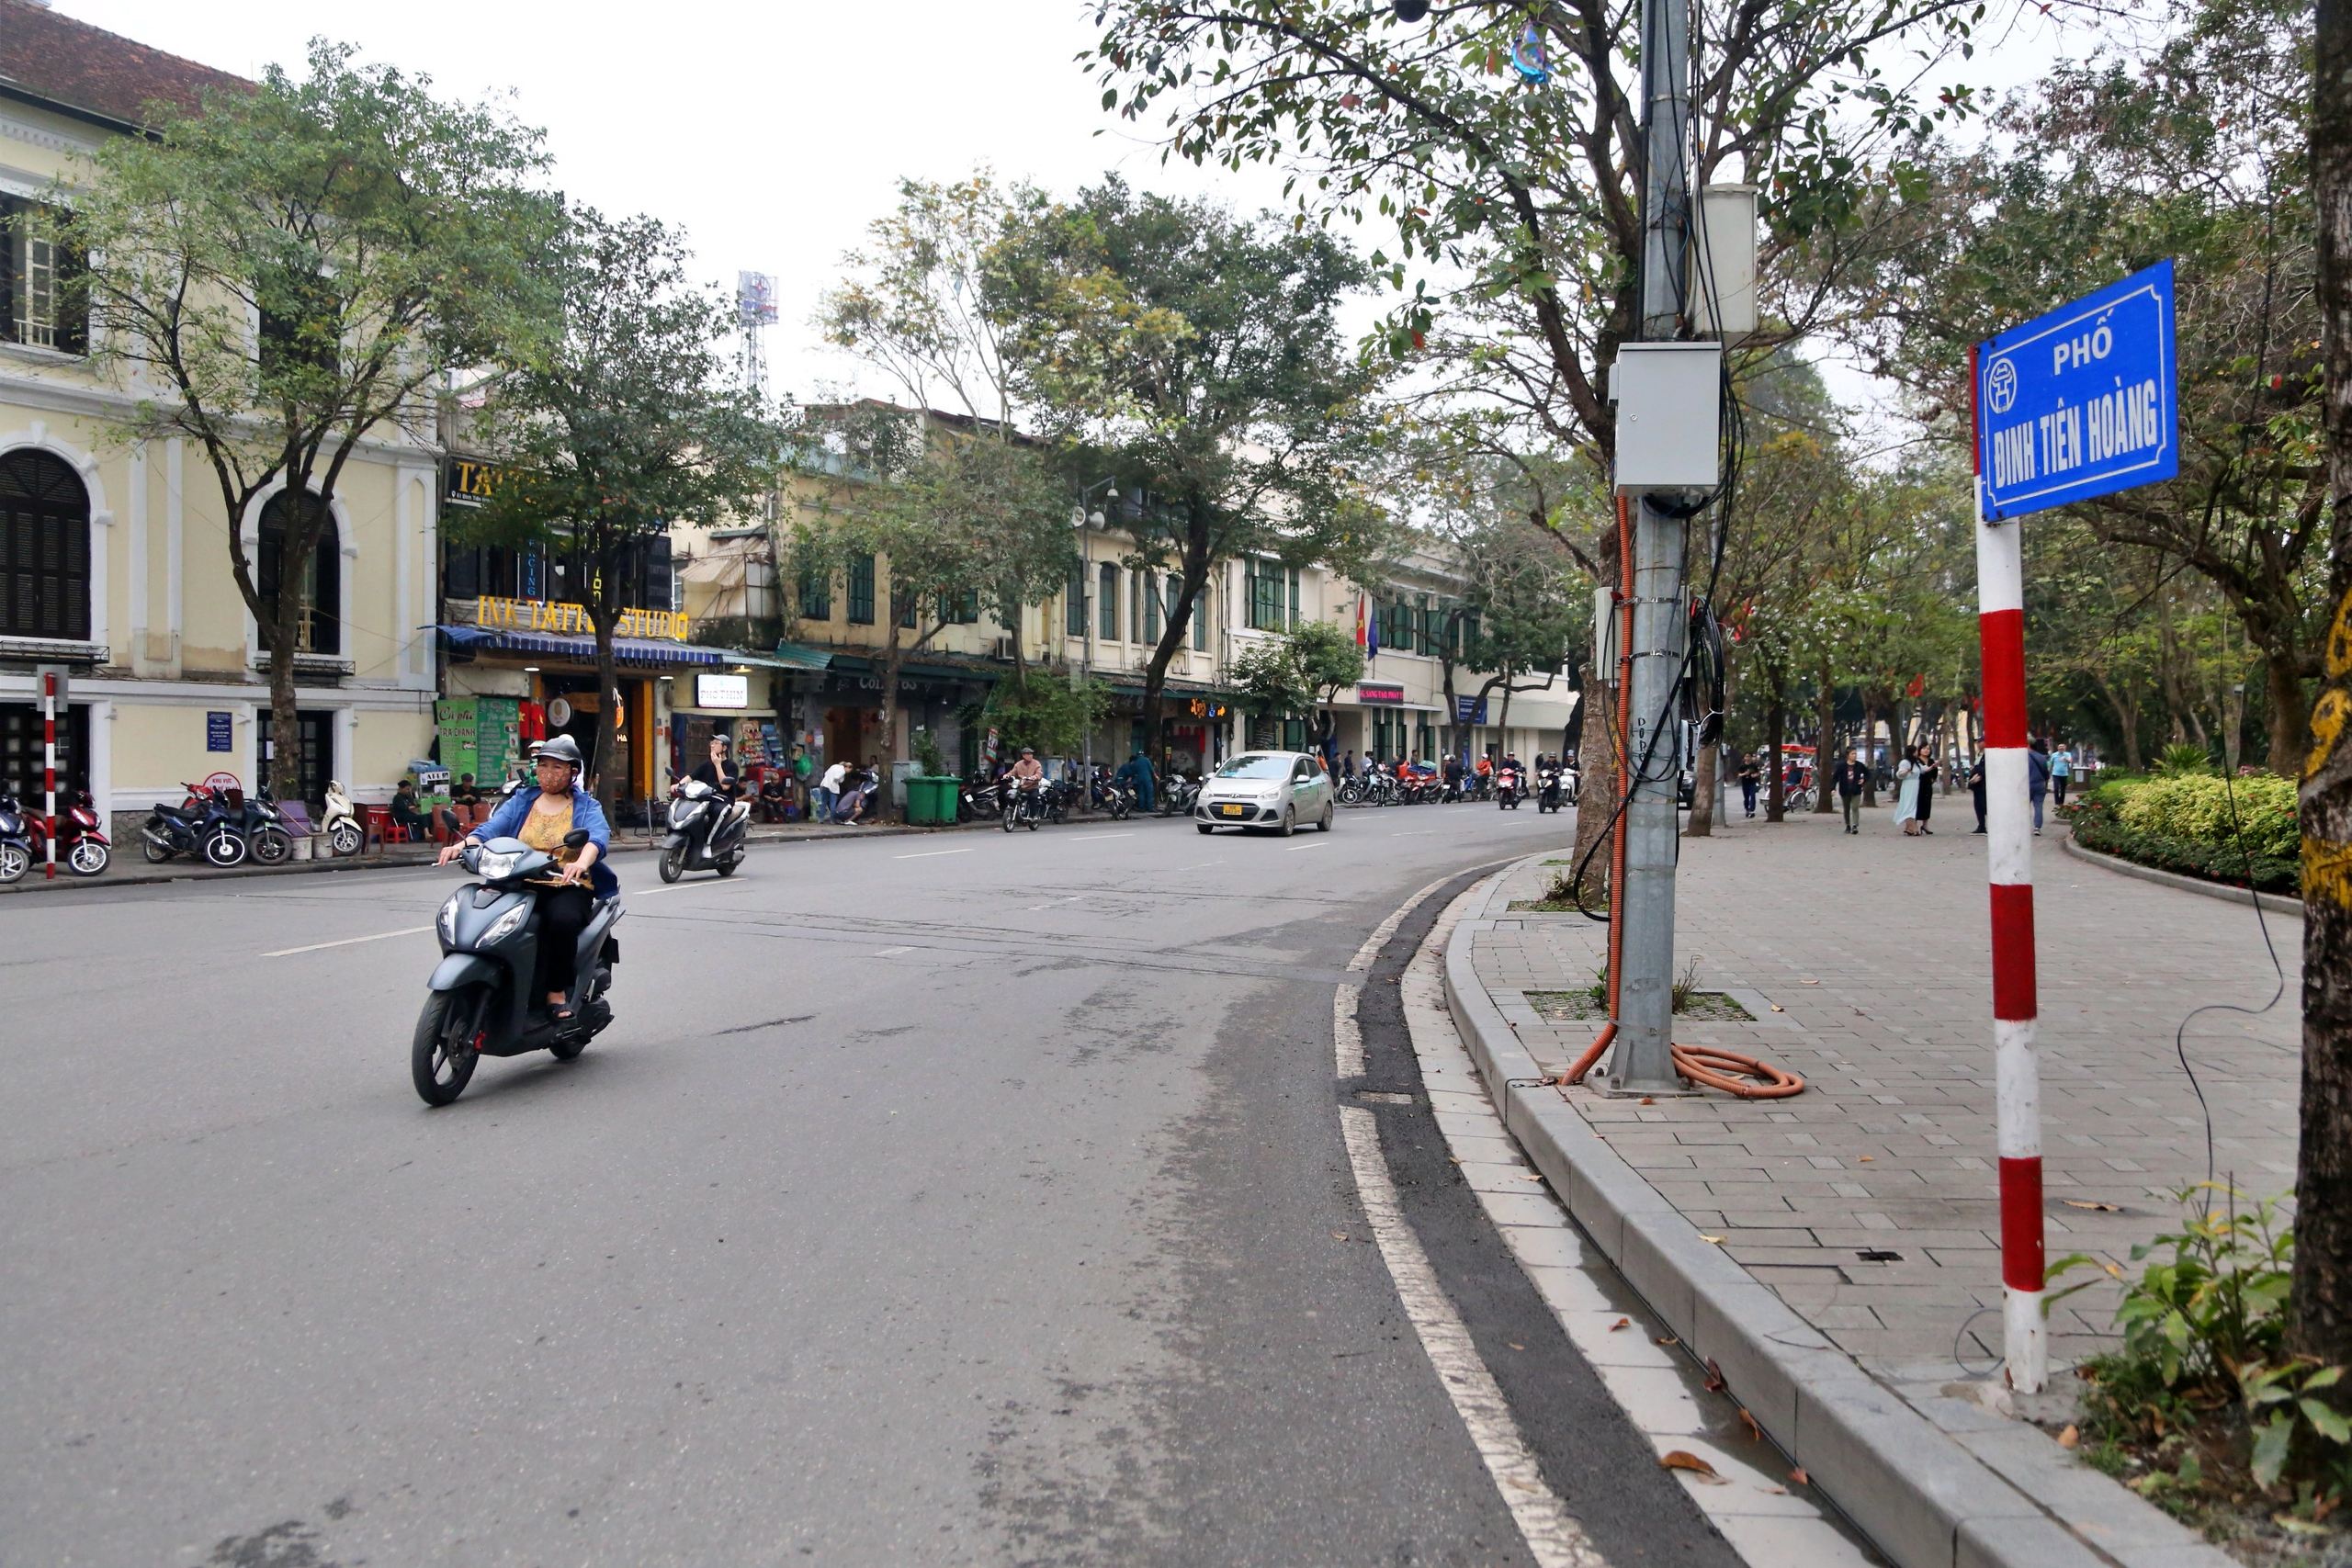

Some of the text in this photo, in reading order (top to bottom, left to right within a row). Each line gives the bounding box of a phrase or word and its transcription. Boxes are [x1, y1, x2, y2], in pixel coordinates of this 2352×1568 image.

[2053, 308, 2114, 376] PHỐ
[1994, 375, 2157, 489] ĐINH TIÊN HOÀNG
[478, 594, 688, 640] INK TATT STUDIO
